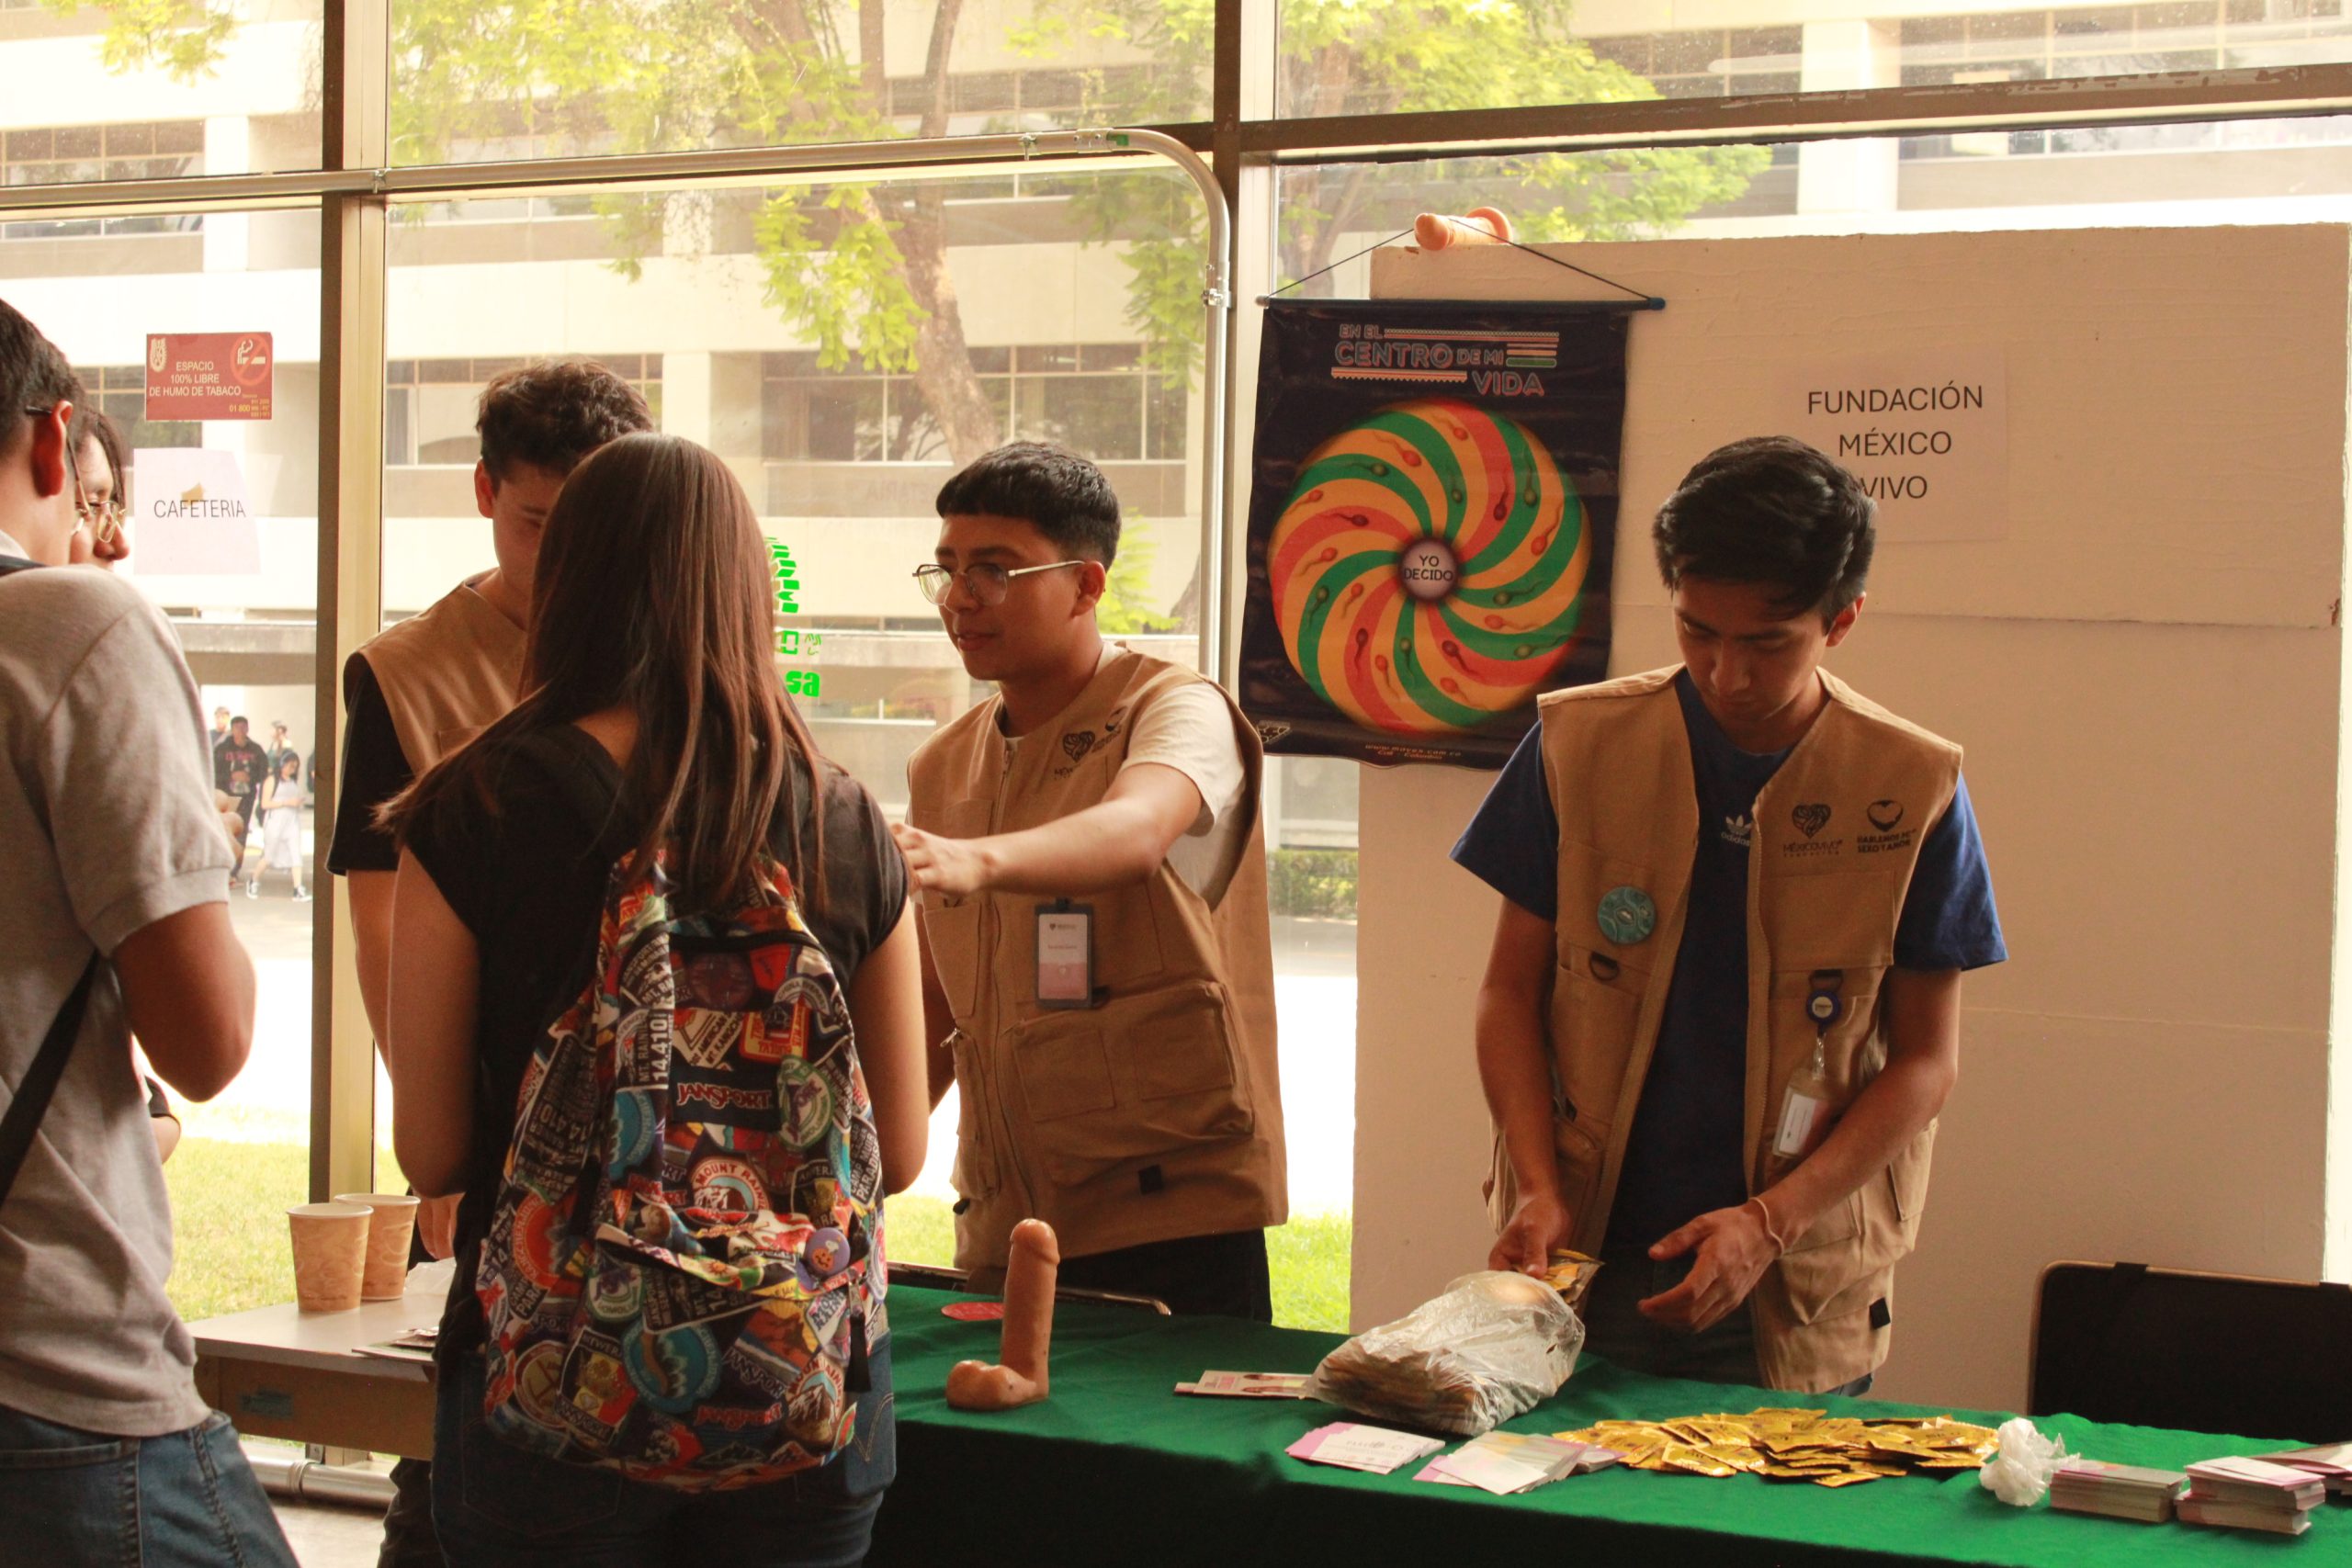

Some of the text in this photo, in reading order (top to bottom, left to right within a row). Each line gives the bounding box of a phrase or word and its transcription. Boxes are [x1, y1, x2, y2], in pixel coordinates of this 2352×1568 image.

[1339, 323, 1383, 340] EN EL
[1334, 340, 1505, 369] CENTRO DE MI
[175, 361, 214, 372] ESPACIO
[170, 374, 220, 384] 100% LIBRE
[1471, 370, 1544, 397] VIDA
[149, 386, 241, 397] DE HUMO DE TABACO
[1807, 379, 1983, 414] FUNDACIÓN
[1838, 427, 1952, 457] MÉXICO
[1860, 475, 1928, 500] VIVO
[153, 500, 246, 518] CAFETERIA
[1419, 555, 1440, 567] YO
[1404, 568, 1453, 581] DECIDO
[676, 1082, 772, 1110] JANSPORT
[695, 1162, 738, 1186] MOUNT
